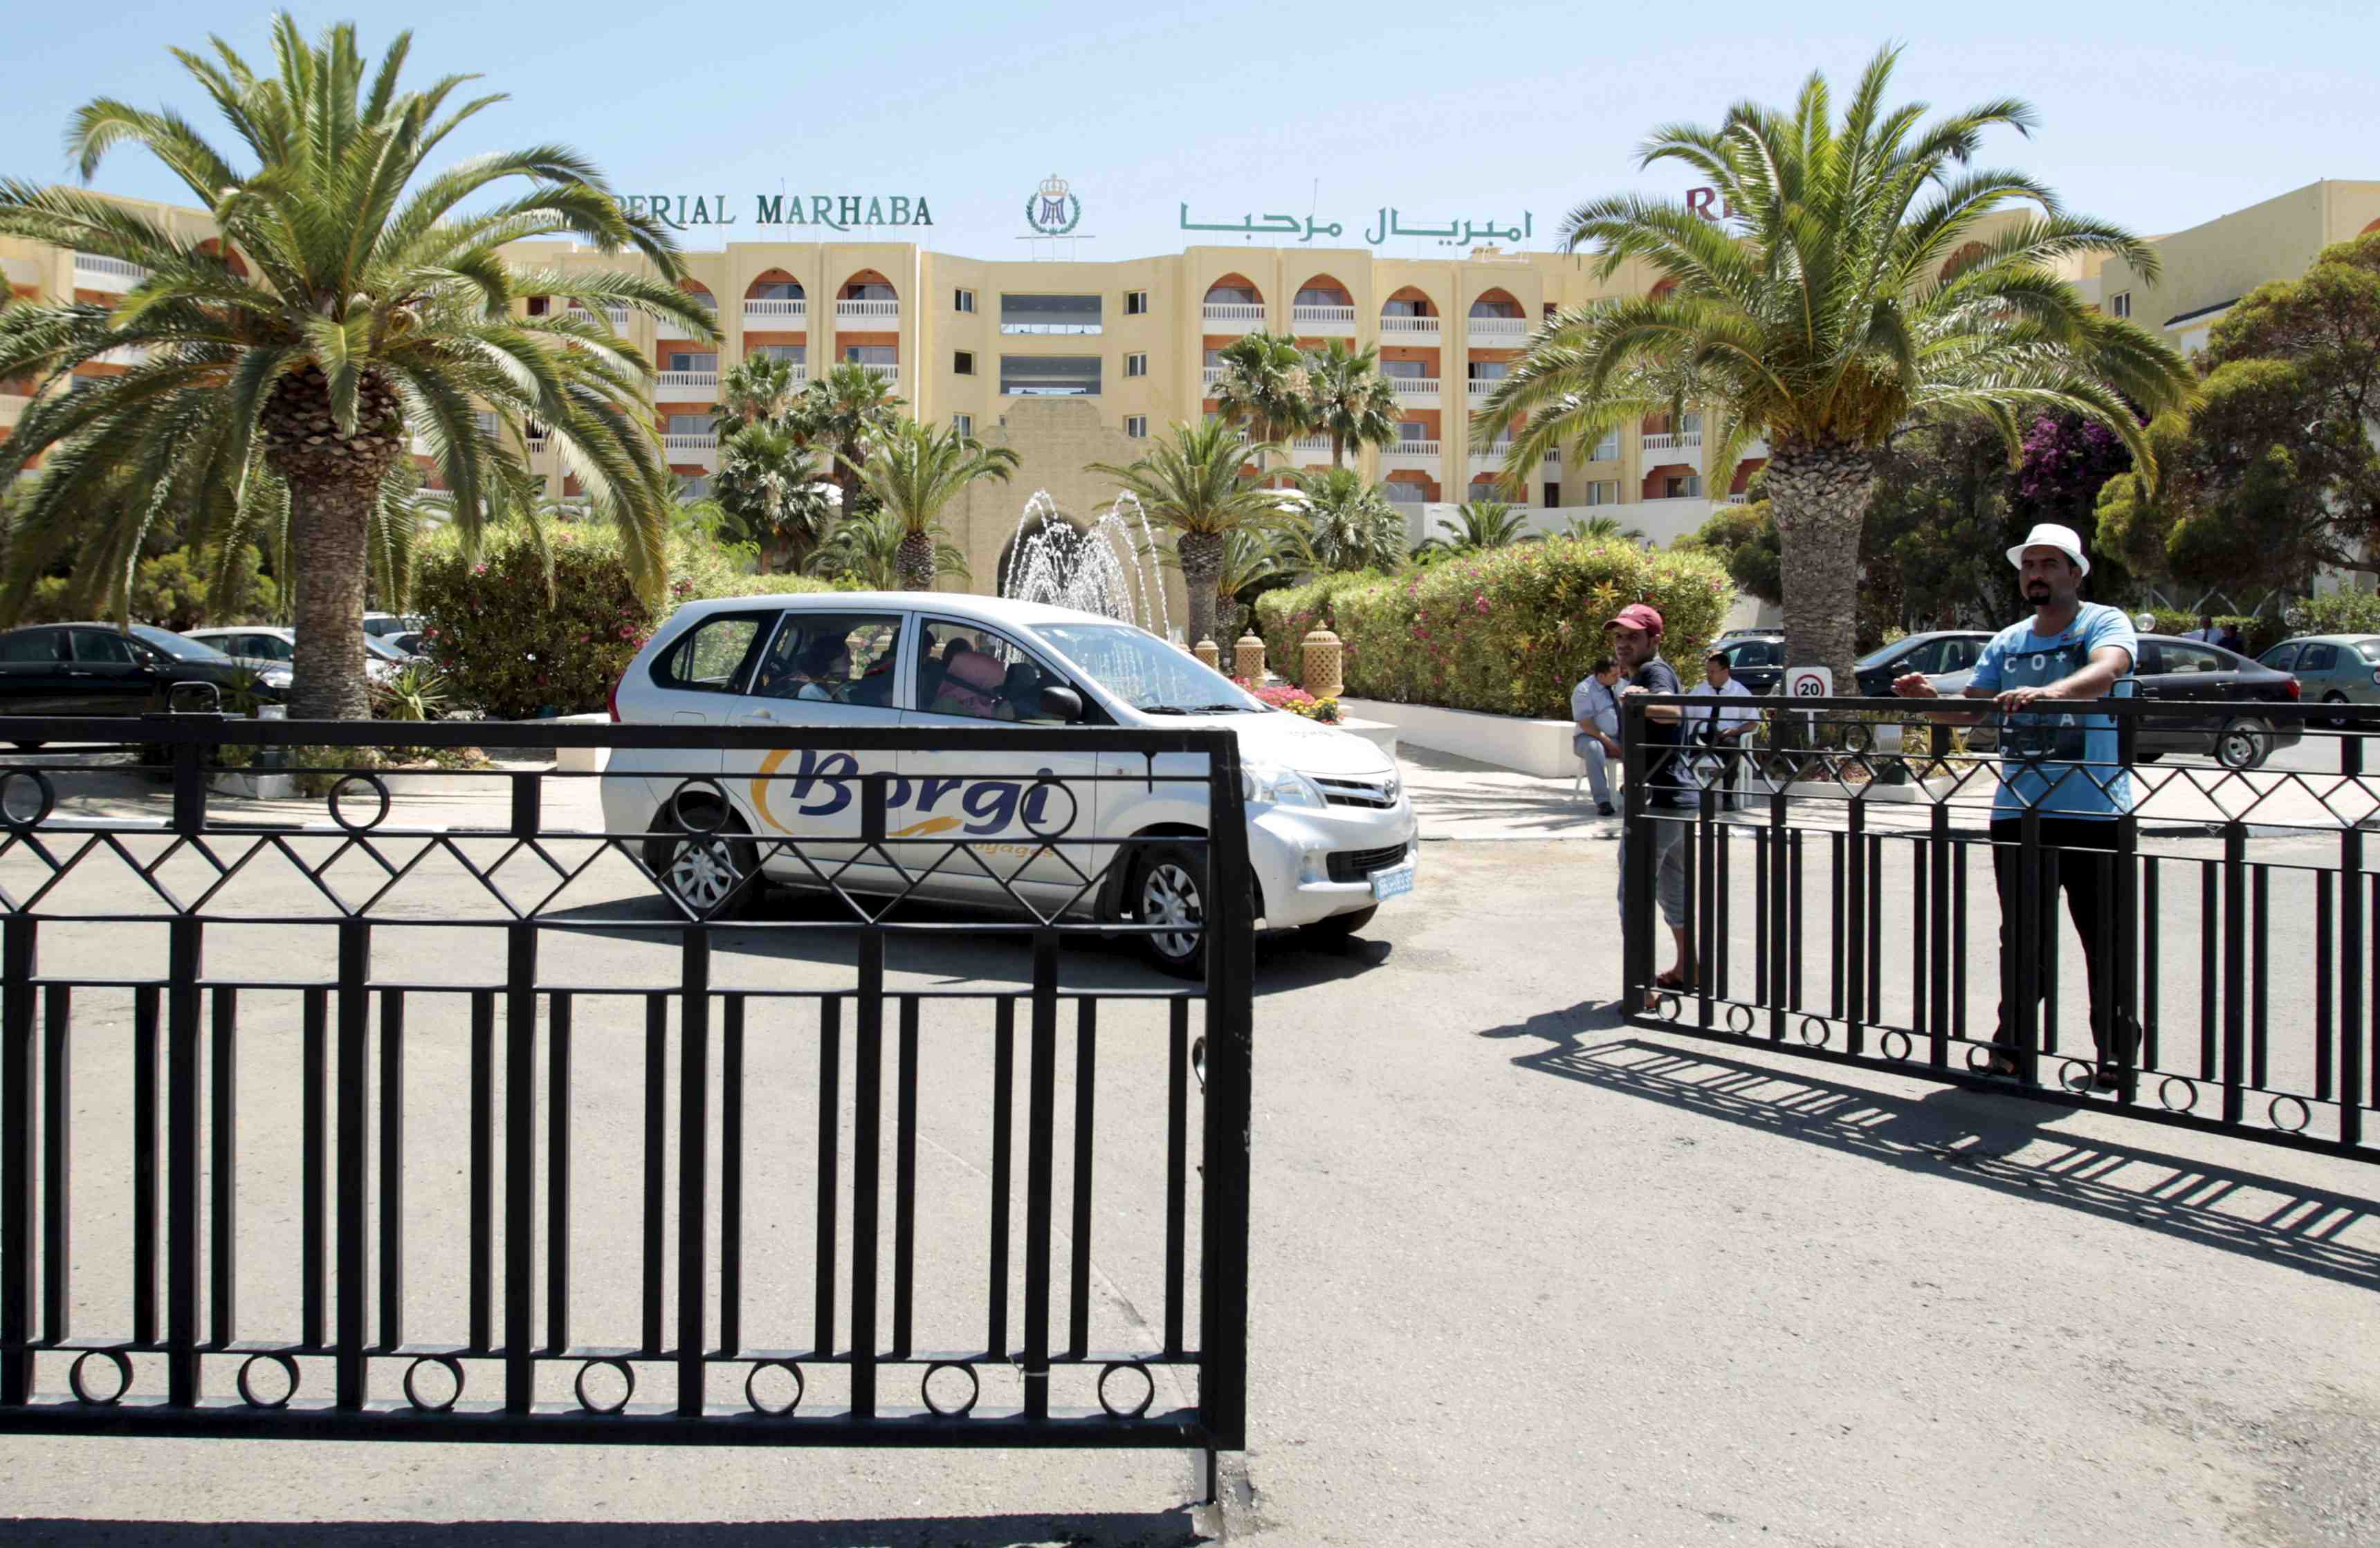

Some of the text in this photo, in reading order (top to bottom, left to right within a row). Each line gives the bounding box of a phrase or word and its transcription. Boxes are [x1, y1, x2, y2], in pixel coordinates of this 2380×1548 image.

[756, 195, 933, 232] MARHABA
[1180, 202, 1532, 246] امبريال مرحبا
[1800, 683, 1819, 696] 20
[790, 749, 1053, 835] Borgi
